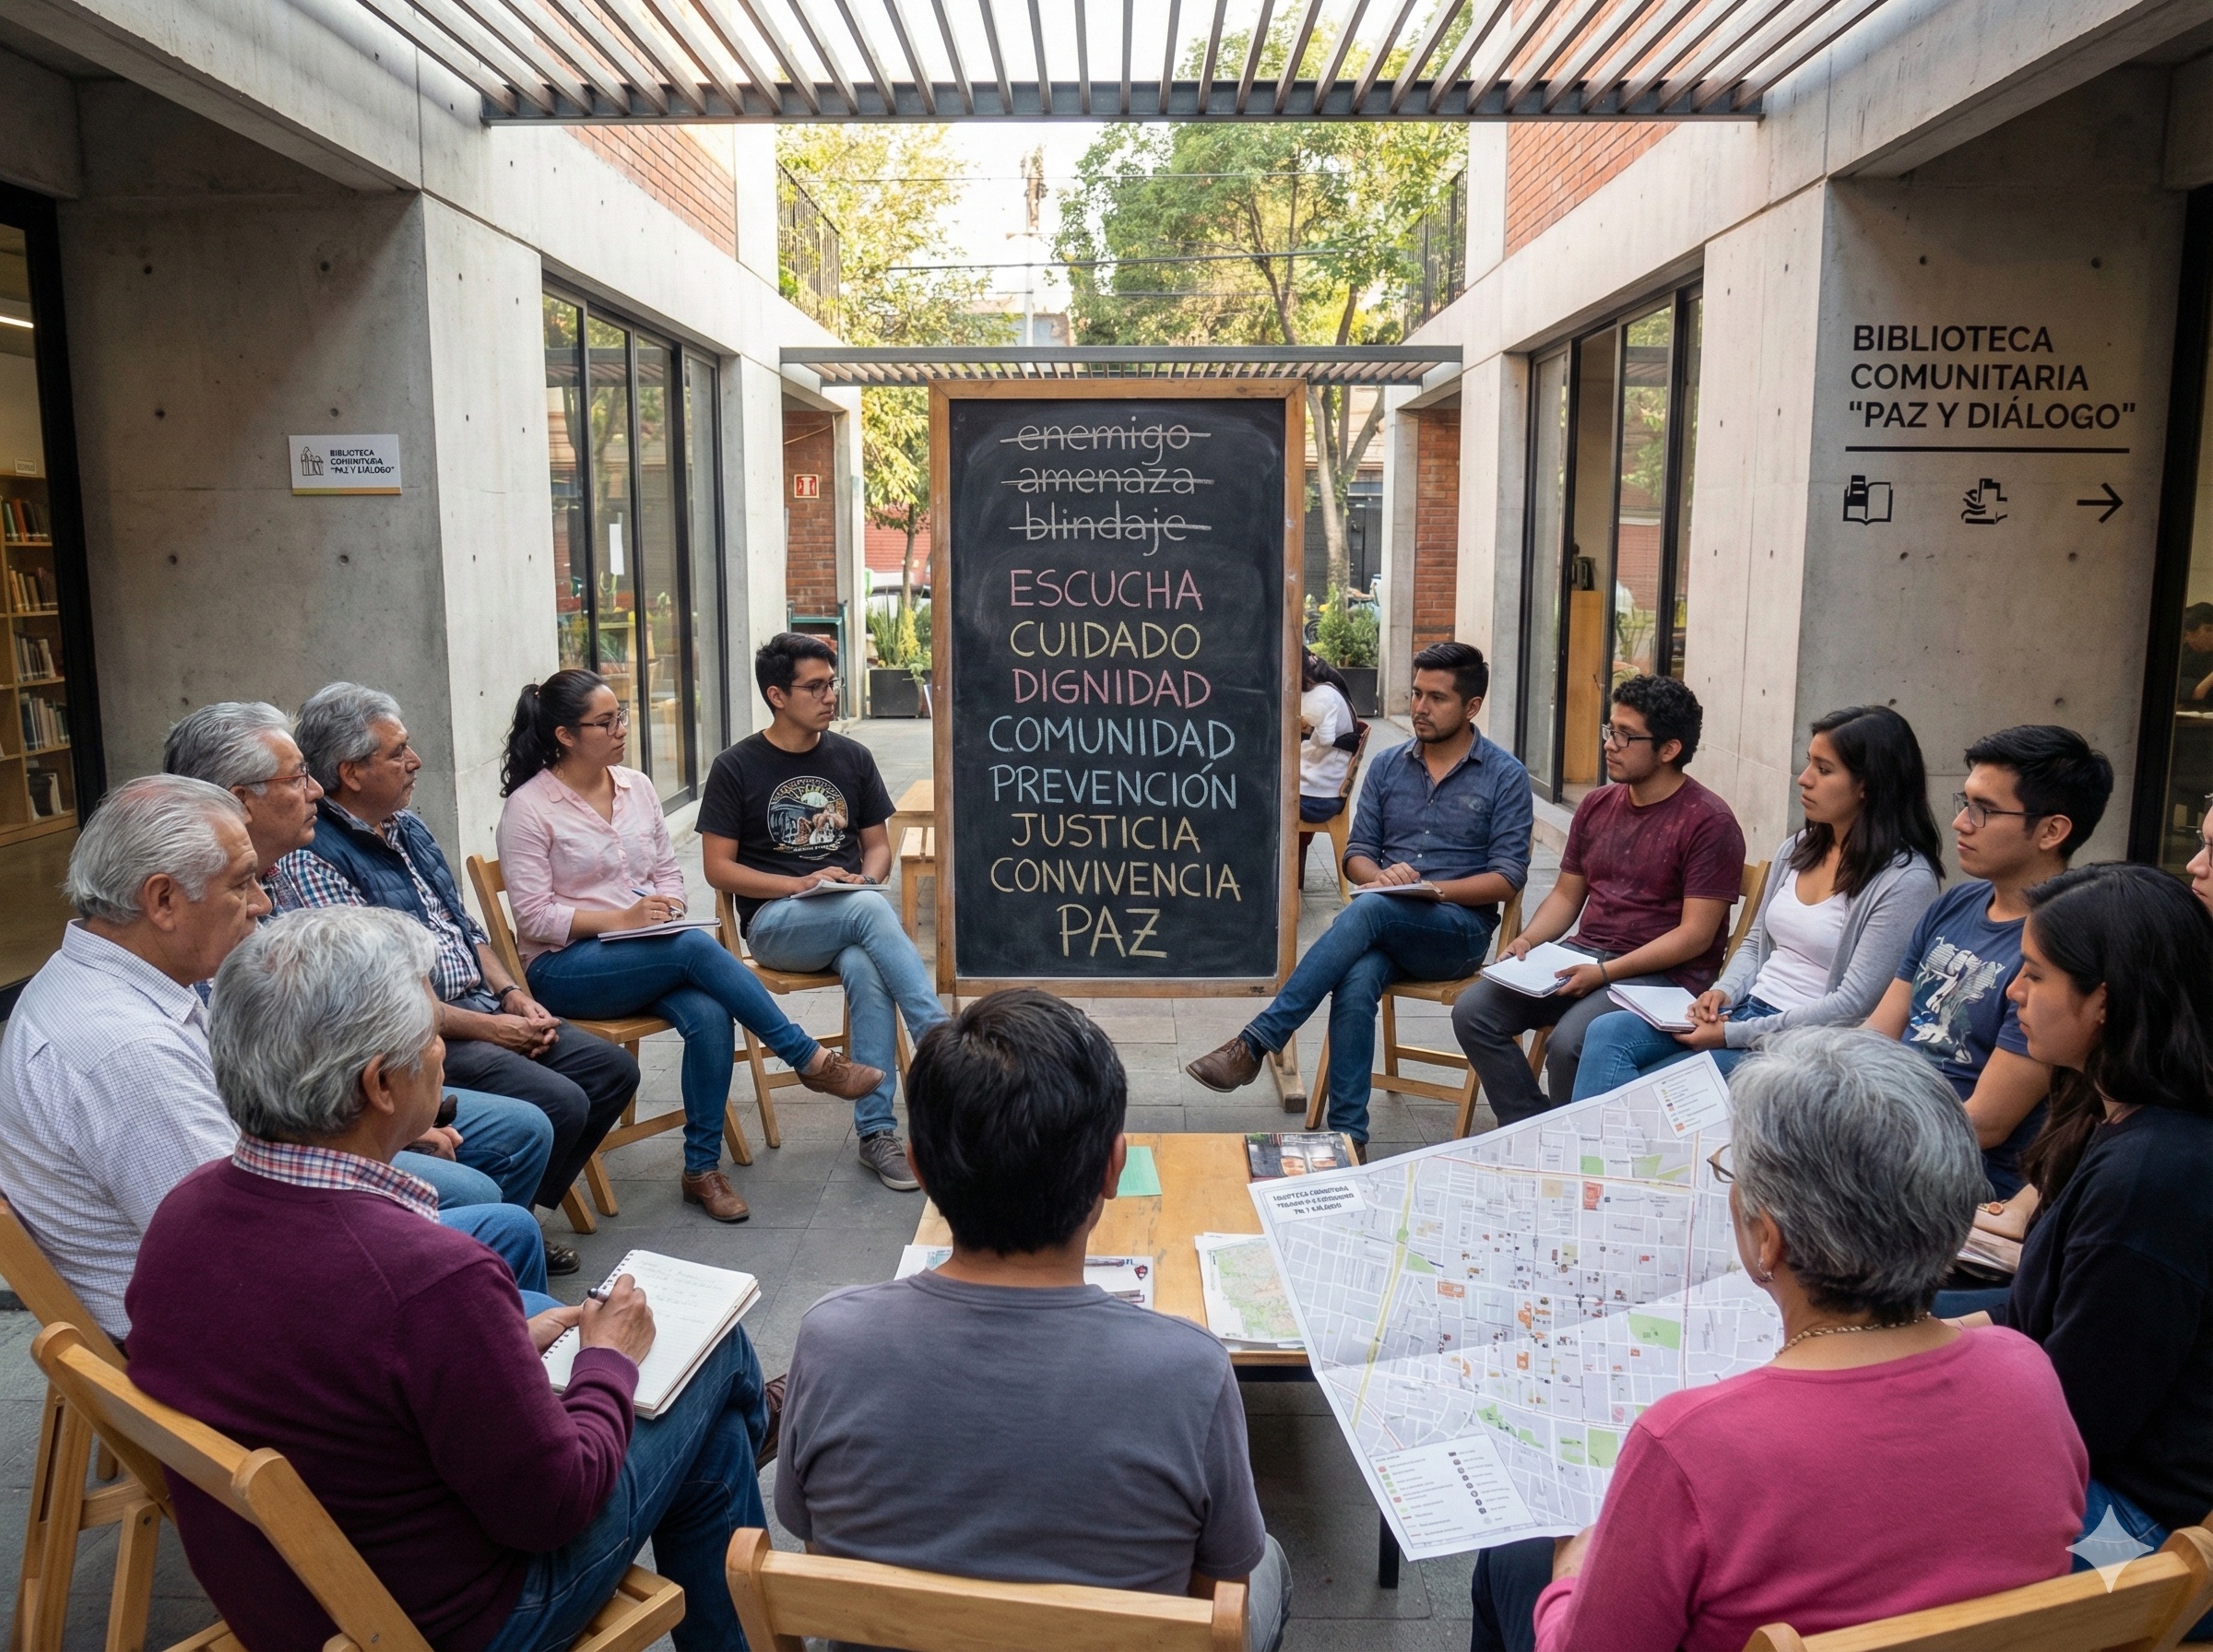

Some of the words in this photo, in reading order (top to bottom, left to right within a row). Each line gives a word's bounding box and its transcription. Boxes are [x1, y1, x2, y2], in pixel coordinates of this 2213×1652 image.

[1852, 324, 2053, 354] BIBLIOTECA
[1851, 363, 2089, 392] COMUNITARIA
[1849, 400, 1928, 429] "PAZ
[1937, 401, 1959, 429] Y
[1967, 395, 2136, 431] DIÁLOGO"
[1017, 415, 1191, 466] enemigo
[1017, 466, 1196, 496] amenaza
[1024, 500, 1188, 557] blindaje
[1010, 569, 1203, 611] ESCUCHA
[1010, 620, 1201, 660] CUIDADO
[1012, 668, 1211, 709] DIGNIDAD
[988, 714, 1236, 761] COMUNIDAD
[988, 763, 1237, 809] PREVENCIÓN
[1011, 812, 1201, 853] JUSTICIA
[990, 857, 1241, 902] CONVIVENCIA
[1056, 904, 1167, 959] PAZ
